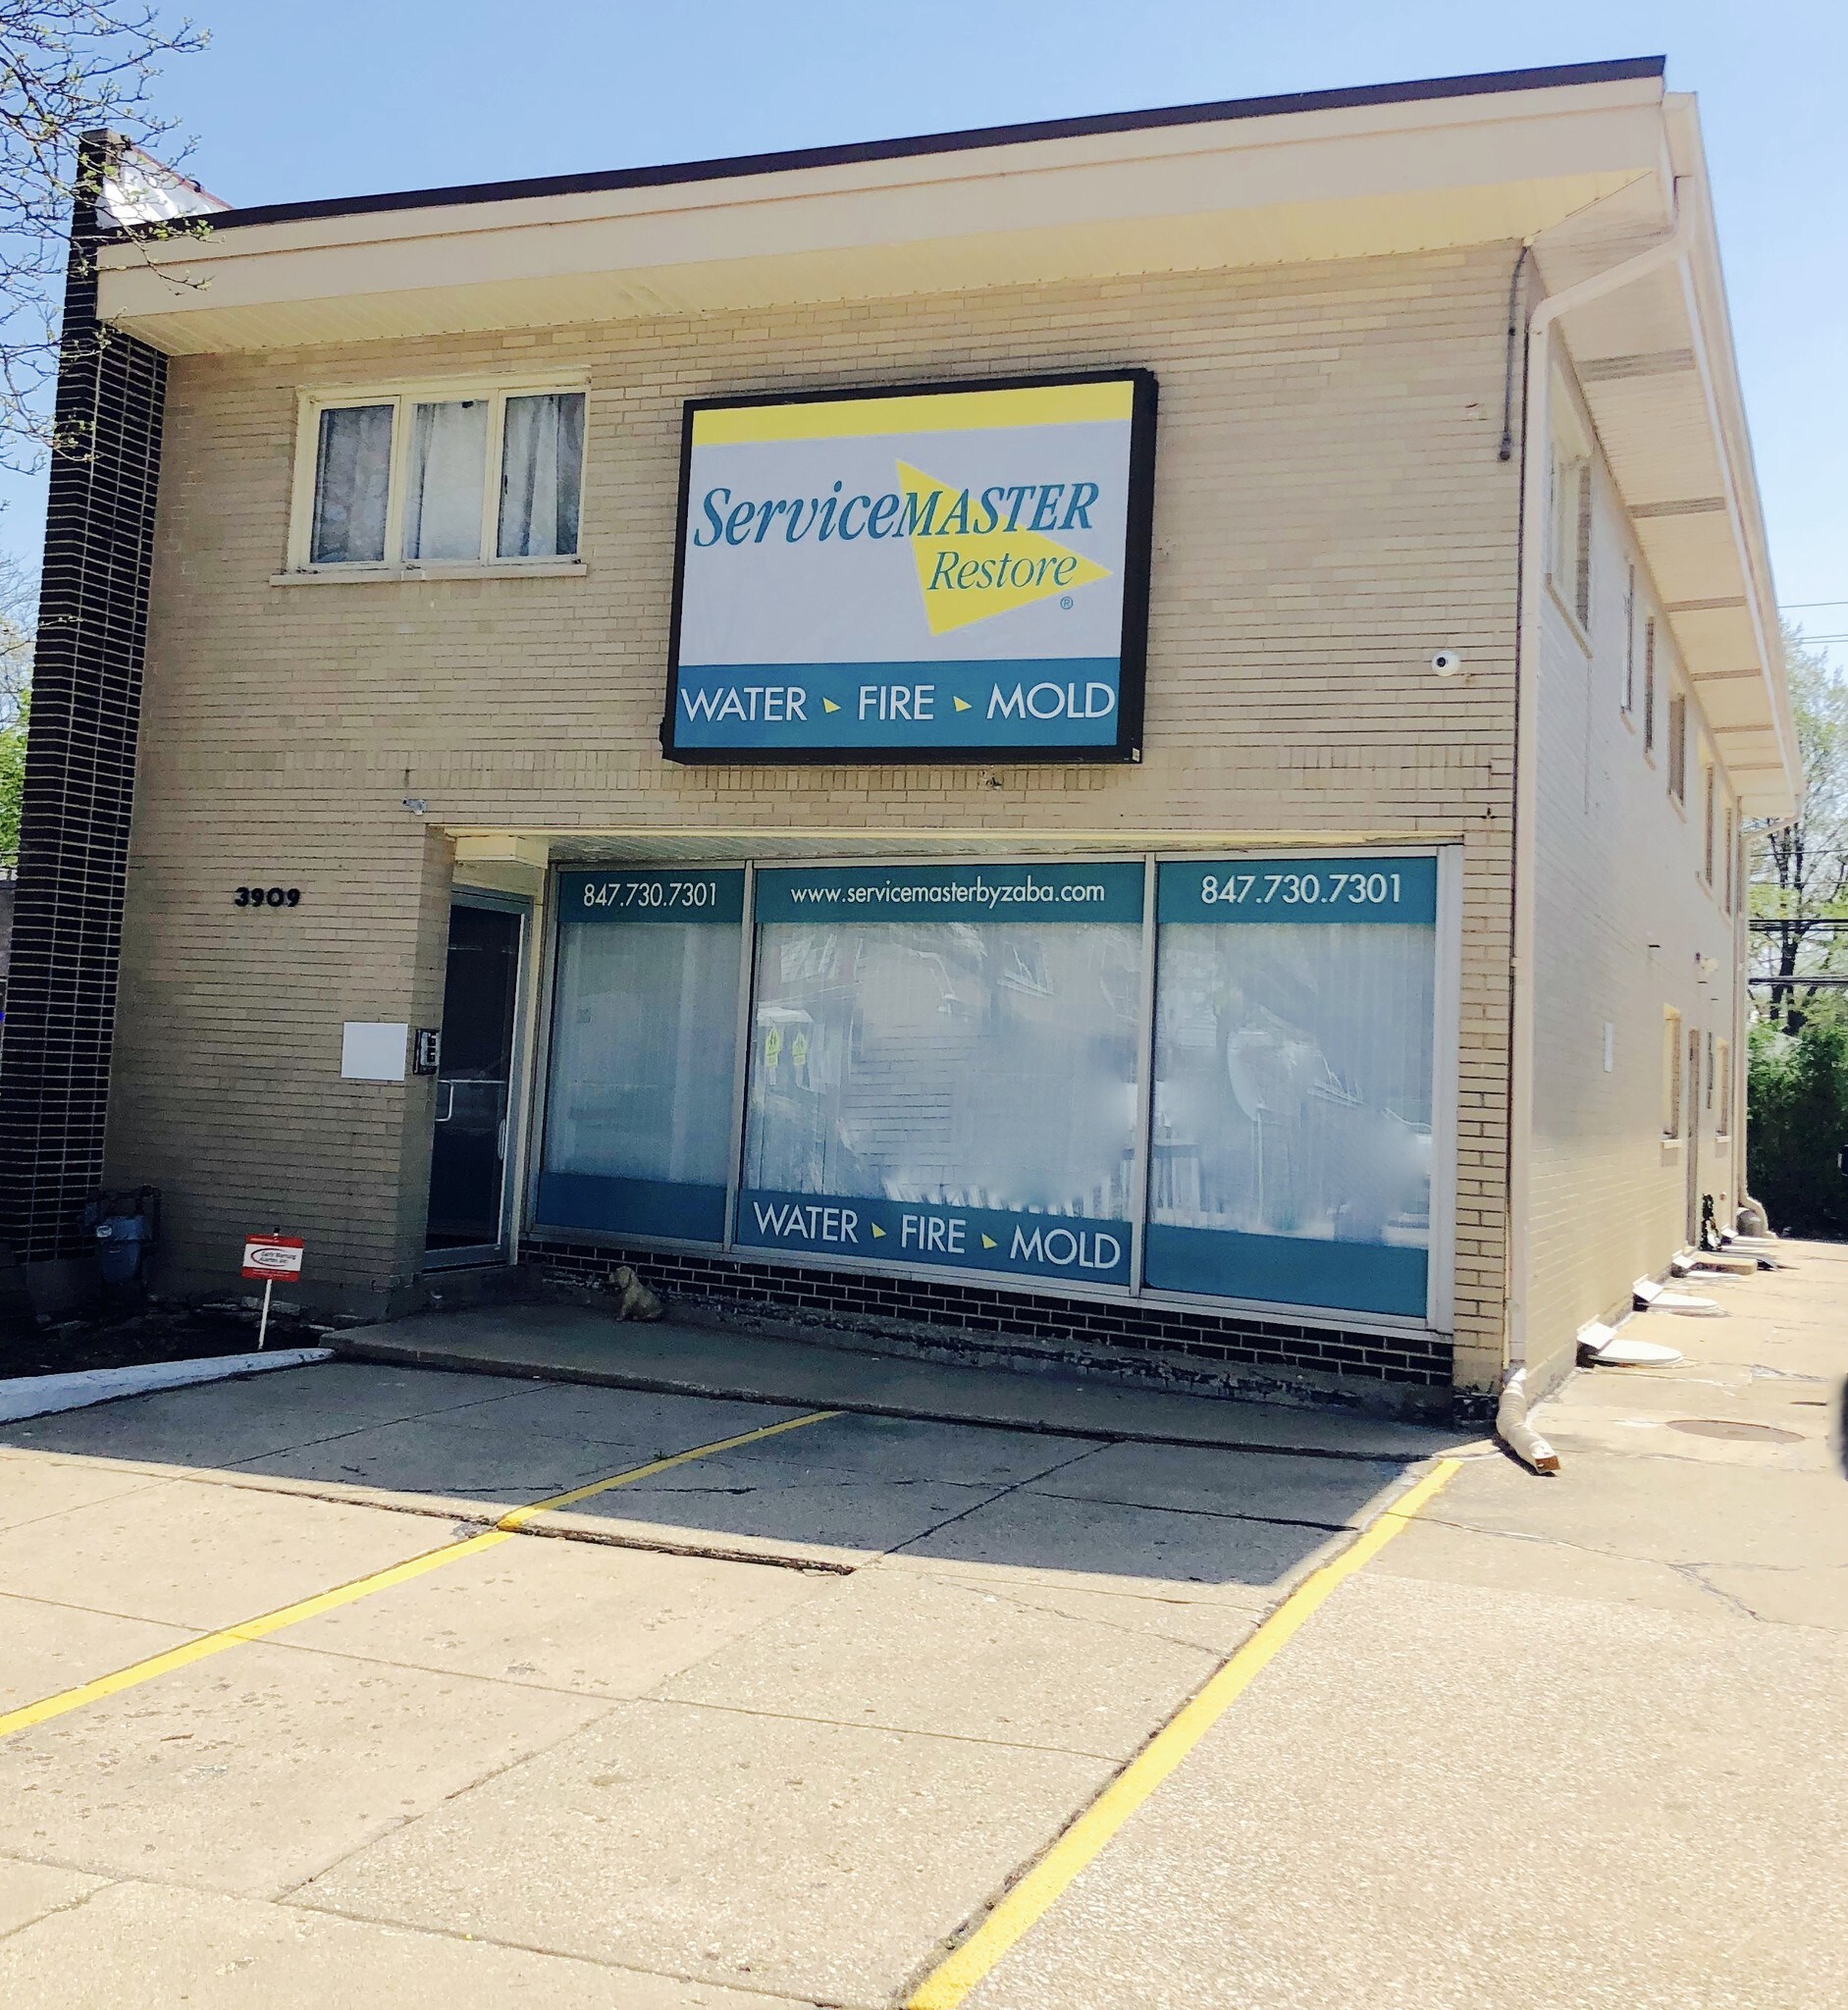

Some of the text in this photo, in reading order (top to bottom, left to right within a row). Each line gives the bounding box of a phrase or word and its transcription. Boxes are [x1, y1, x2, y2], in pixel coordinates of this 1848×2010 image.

[926, 551, 1078, 591] Restore
[681, 681, 1116, 721] WATER FIRE MOLD
[235, 887, 300, 907] 3909
[584, 882, 716, 907] 847.730.7301
[791, 875, 1105, 909] www.servicemasterbyzaba.com
[1201, 873, 1400, 904] 847.730.7301
[753, 1201, 1121, 1269] WATER FIRE MOLD
